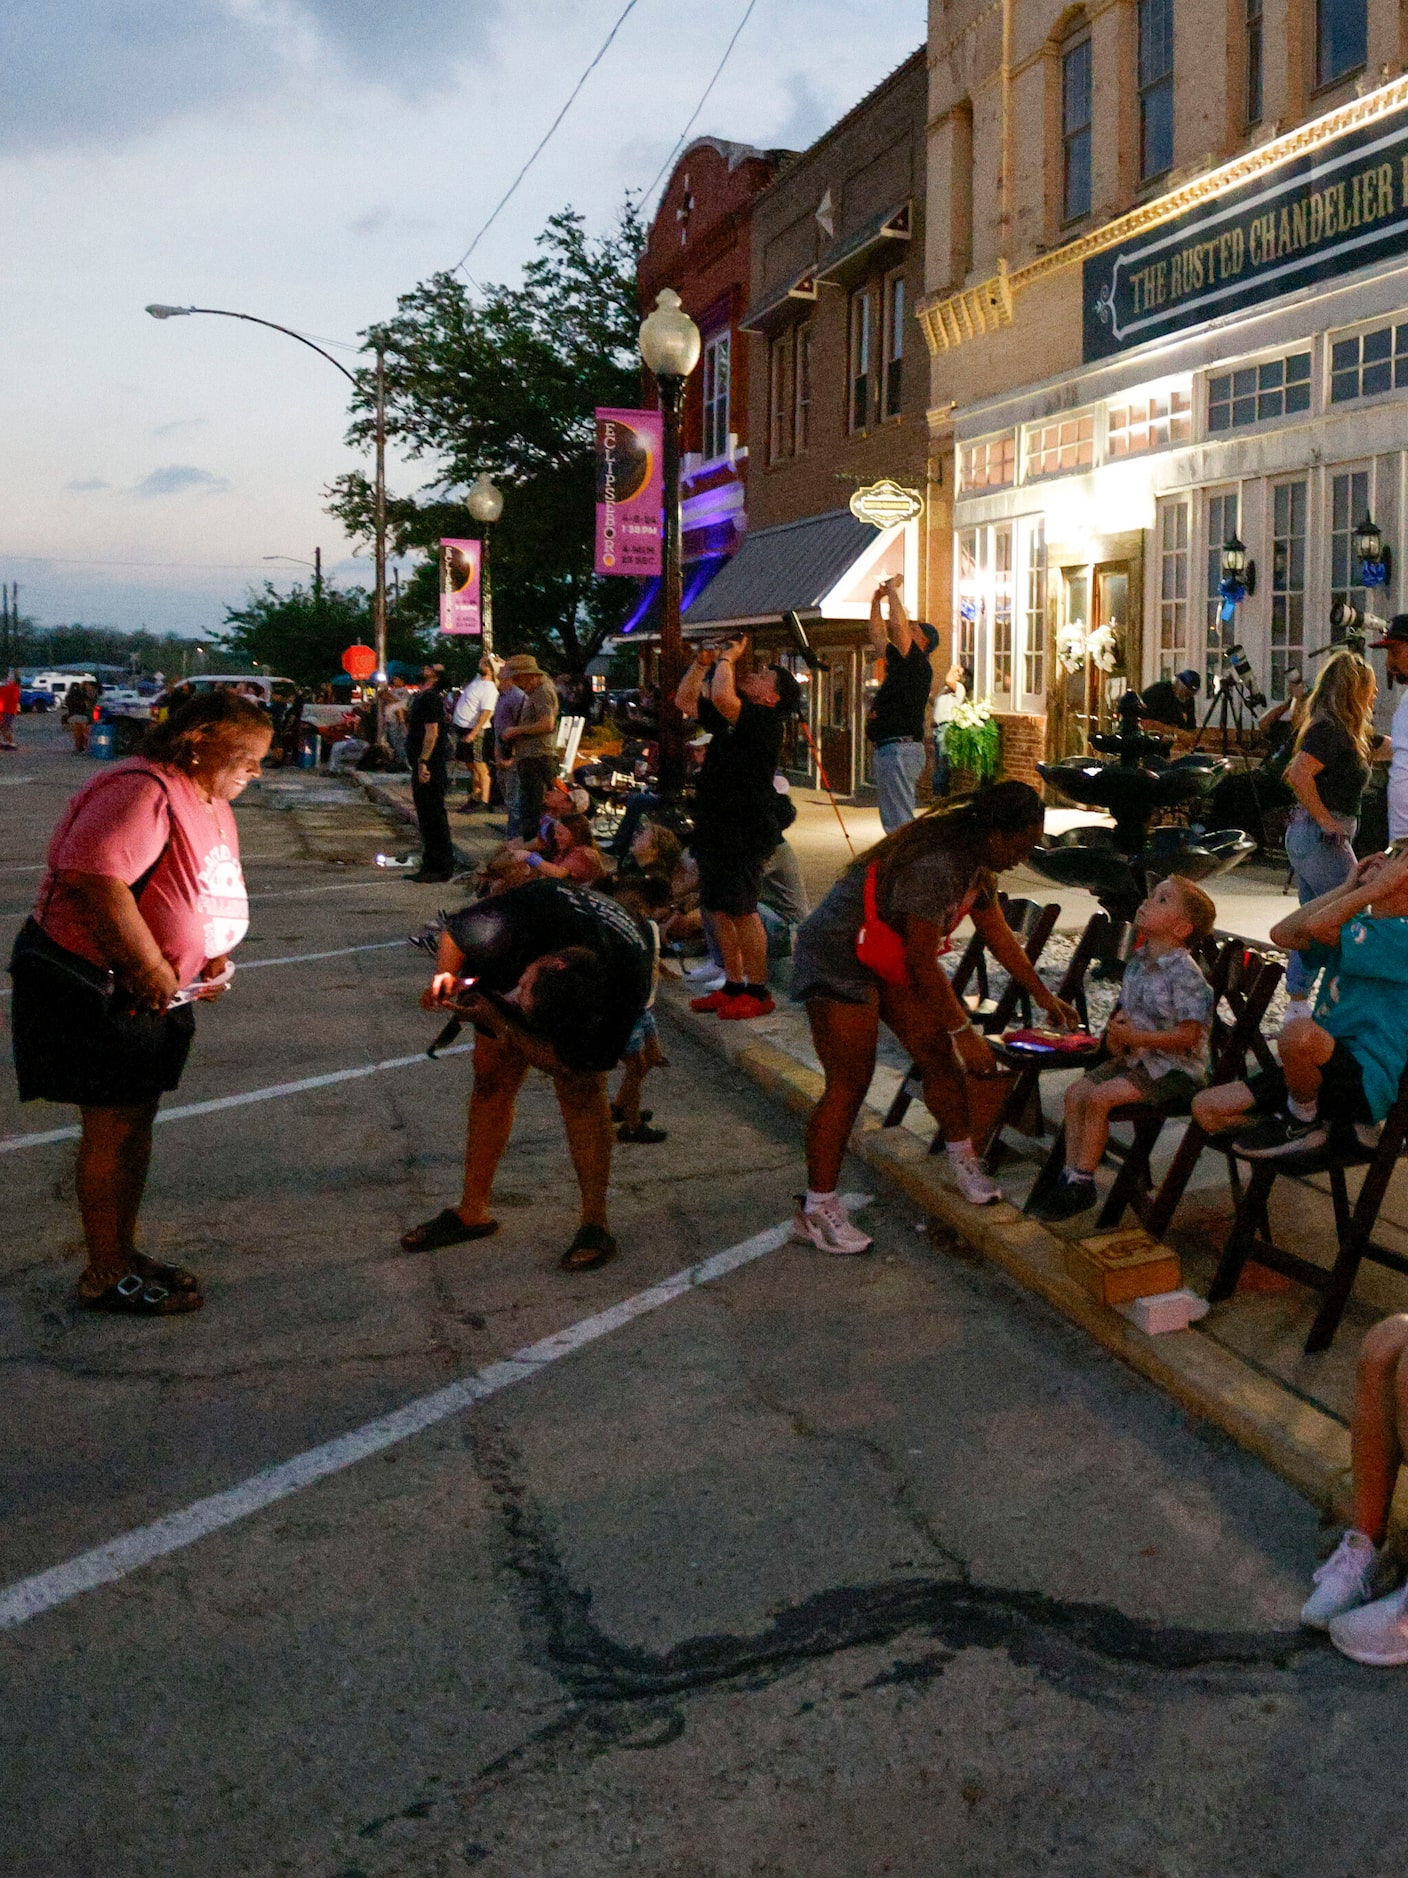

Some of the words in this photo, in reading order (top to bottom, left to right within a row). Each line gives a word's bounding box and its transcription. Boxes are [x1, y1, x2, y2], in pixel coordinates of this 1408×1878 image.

[1129, 261, 1167, 313] THE
[1171, 227, 1244, 299] RUSTED
[1250, 163, 1395, 267] CHANDELIER
[604, 423, 616, 567] ECLIPSEBORO
